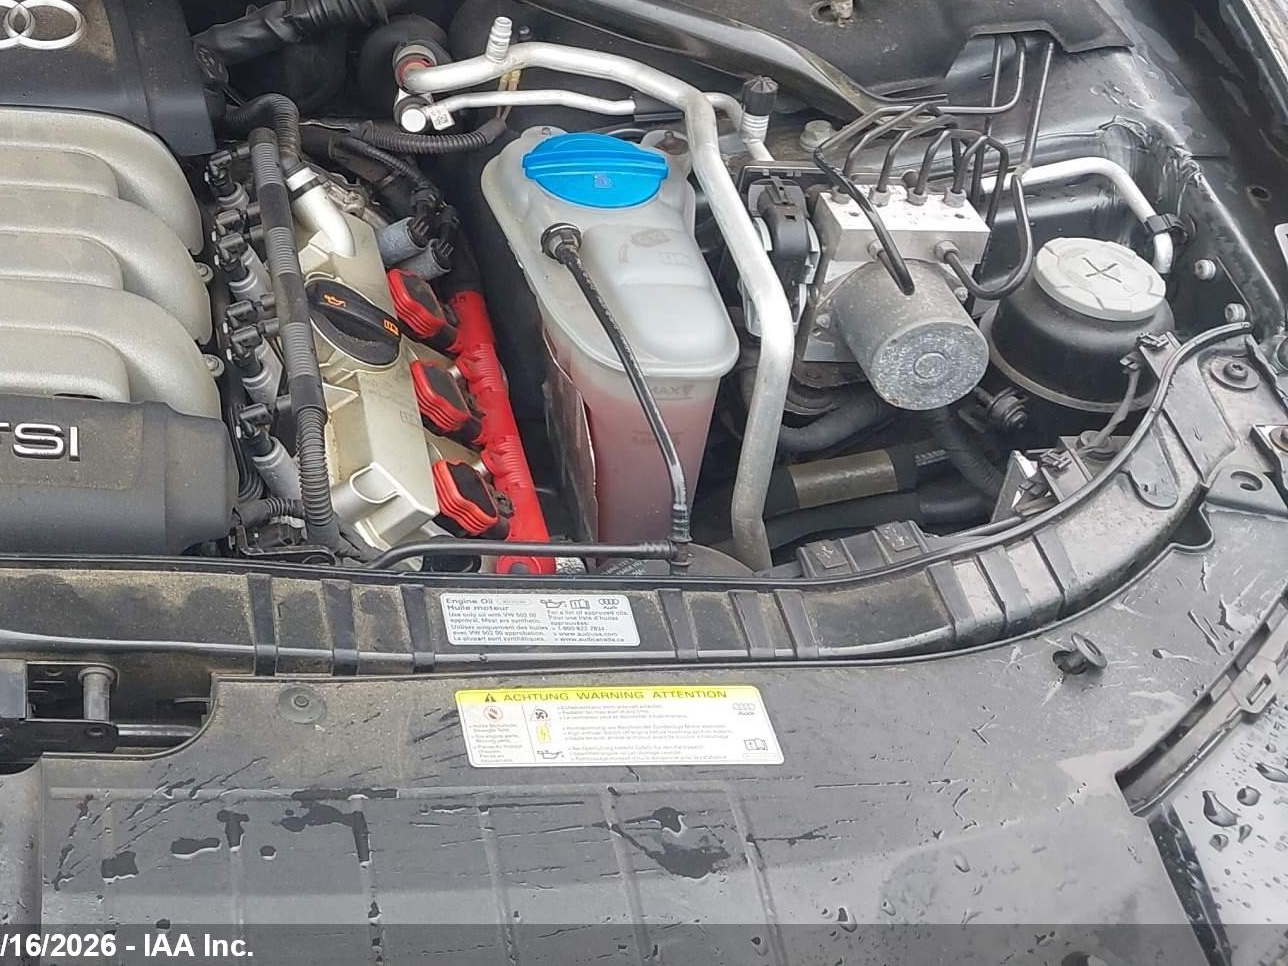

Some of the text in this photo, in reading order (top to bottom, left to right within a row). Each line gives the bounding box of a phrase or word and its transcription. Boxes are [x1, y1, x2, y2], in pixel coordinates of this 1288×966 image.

[503, 690, 727, 702] ACHTUNG WARNING ATTENTION
